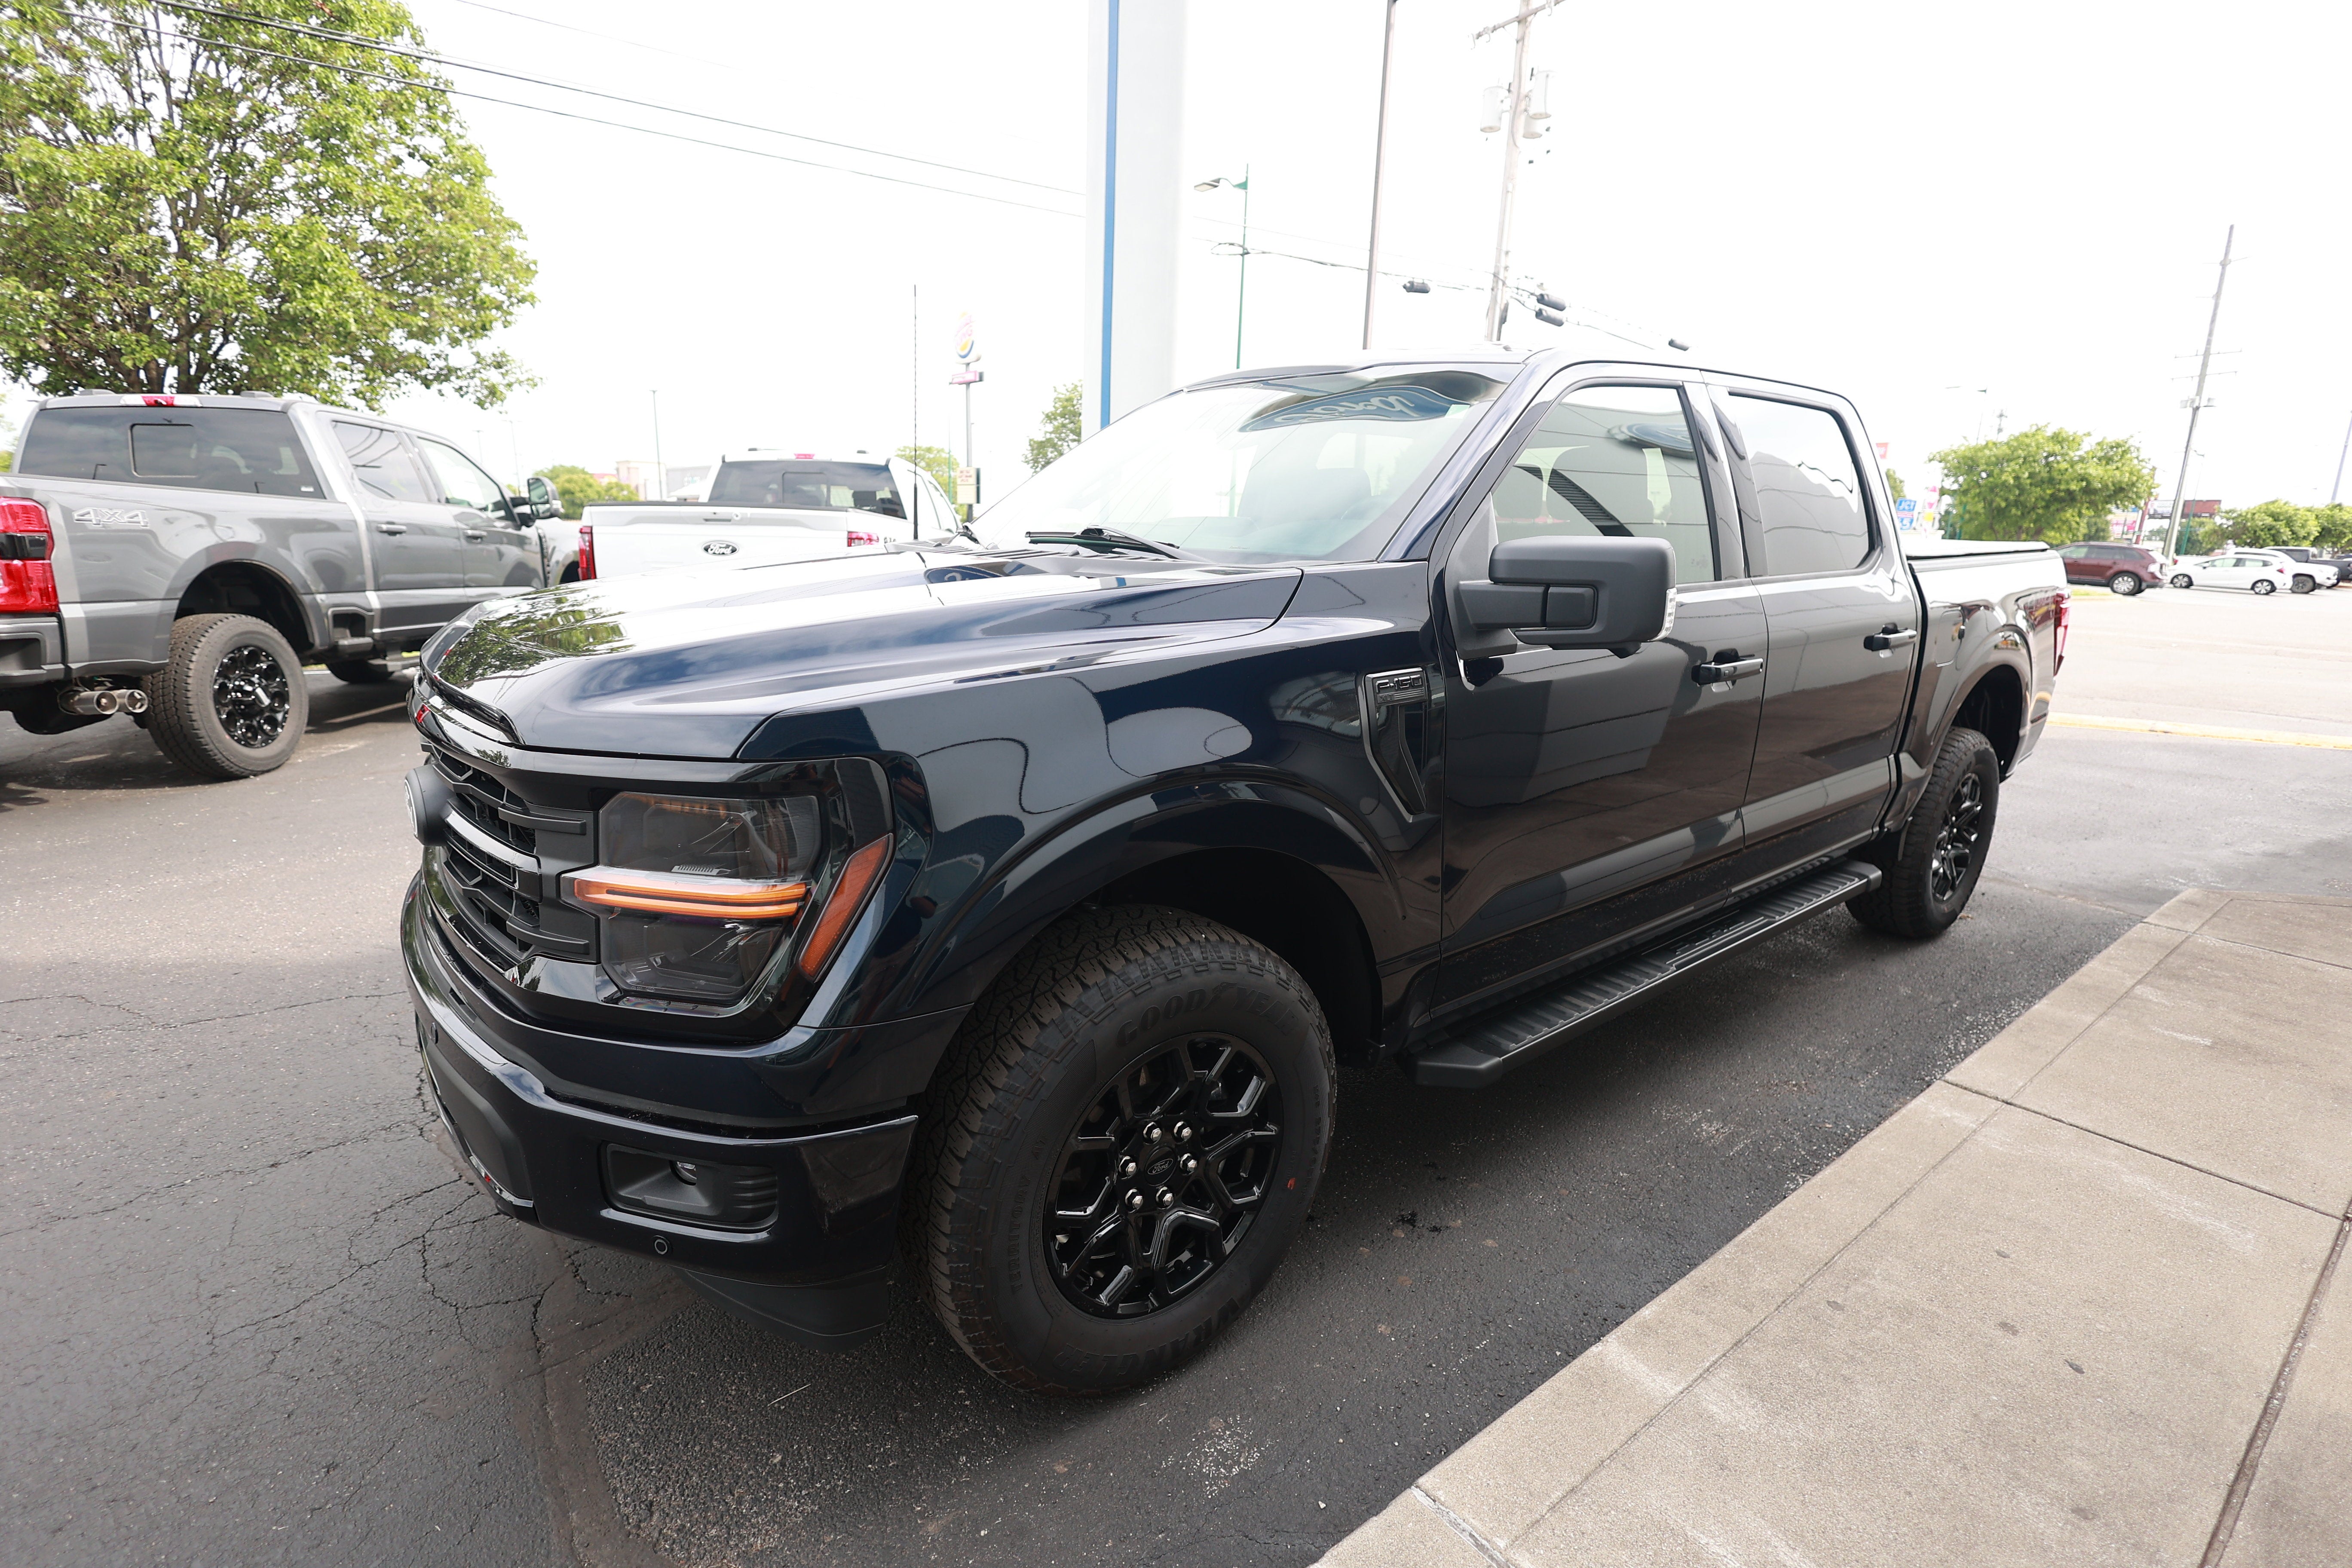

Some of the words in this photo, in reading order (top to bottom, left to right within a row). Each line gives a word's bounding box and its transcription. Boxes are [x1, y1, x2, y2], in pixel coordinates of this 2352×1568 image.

[707, 542, 732, 554] Ford
[1375, 674, 1422, 693] F-150
[1379, 694, 1393, 702] XLT
[1115, 982, 1300, 1047] GOODYEAR
[1152, 1161, 1170, 1173] Ford
[1008, 1174, 1031, 1294] TERRITORY
